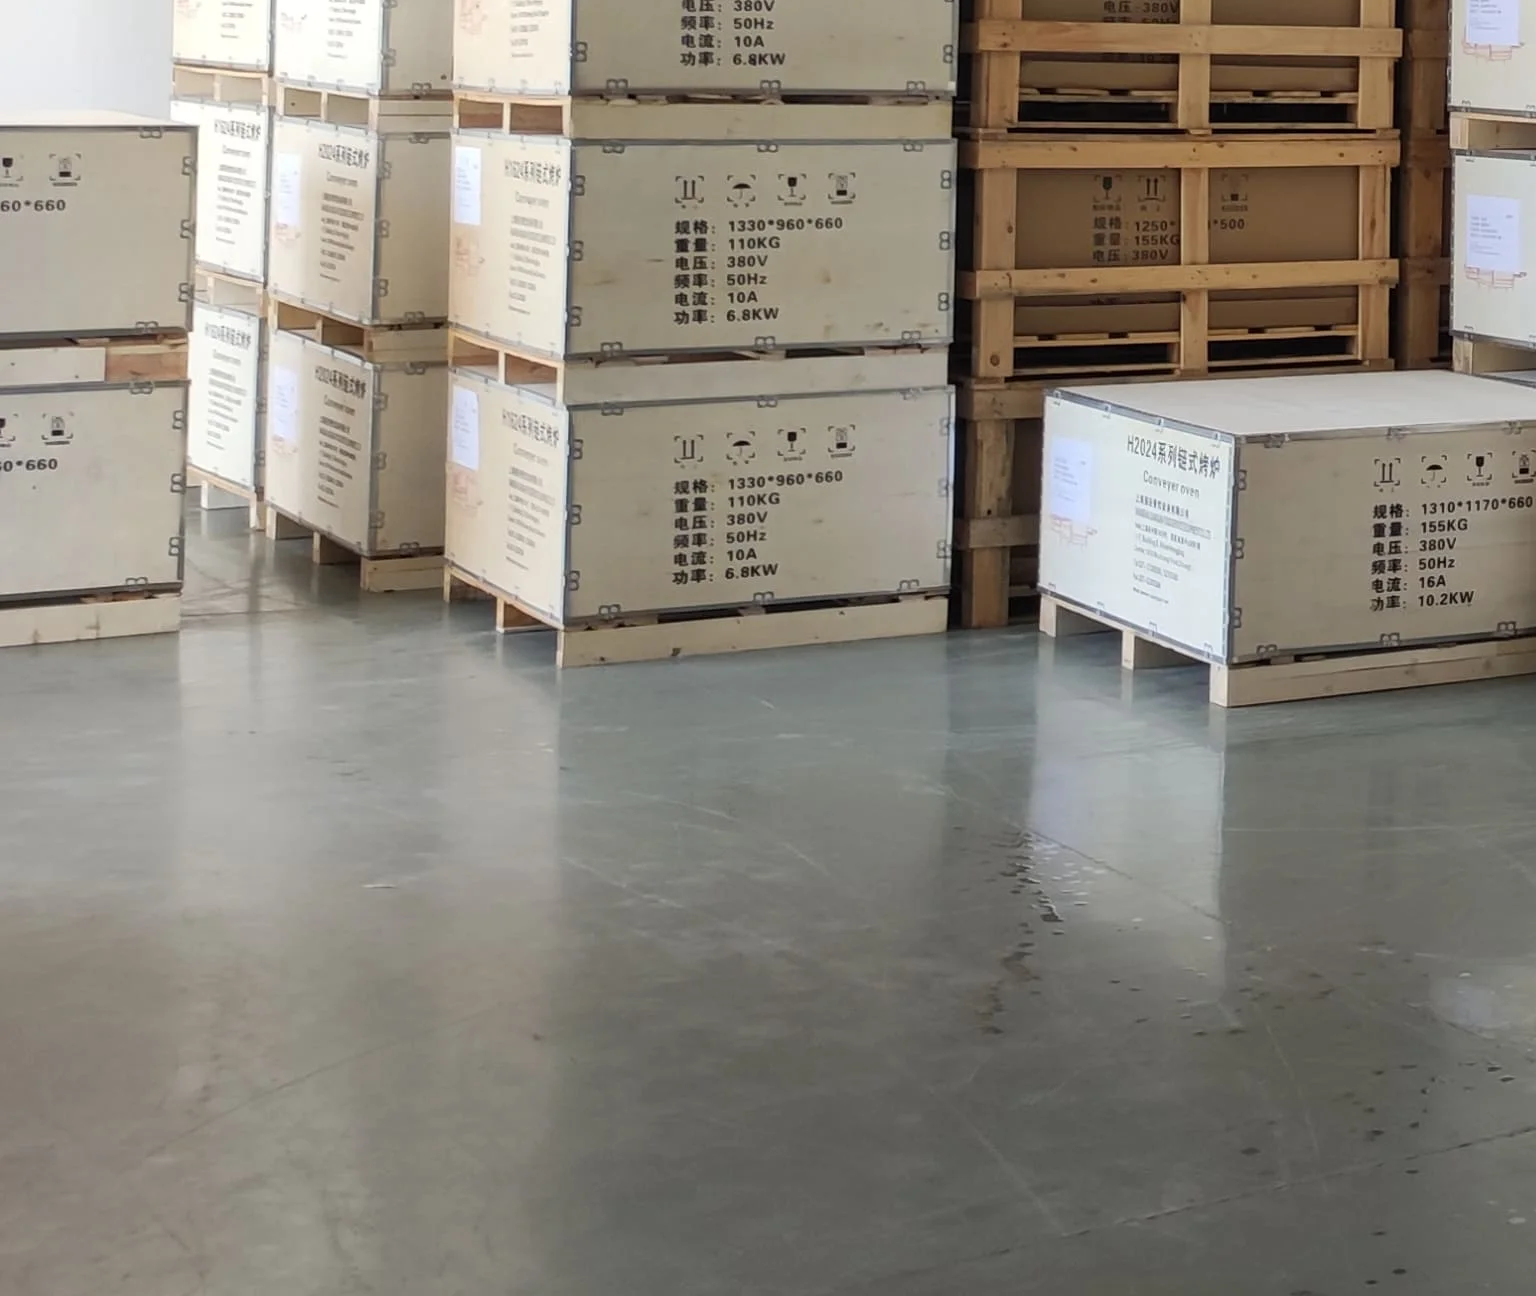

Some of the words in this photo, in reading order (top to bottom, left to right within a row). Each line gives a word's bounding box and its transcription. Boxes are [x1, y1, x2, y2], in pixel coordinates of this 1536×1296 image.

[733, 0, 775, 12] 380V
[733, 17, 774, 30] 50Hz
[734, 35, 764, 48] 10A
[733, 53, 785, 66] 6.8KW
[729, 236, 780, 251] 110KG
[1134, 234, 1180, 246] 155KG
[727, 255, 768, 268] 380V
[1132, 250, 1169, 261] 380V
[727, 273, 767, 286] 50Hz
[727, 290, 758, 304] 10A
[726, 308, 779, 322] 6.8KW
[1127, 434, 1221, 480] H2024系列链式烤炉
[1143, 470, 1179, 493] Conveyer
[1180, 484, 1200, 499] oven
[728, 492, 780, 508] 110KG
[727, 511, 768, 526] 380V
[1421, 518, 1468, 533] 155KG
[726, 530, 766, 544] 50Hz
[1419, 537, 1456, 552] 380V
[727, 548, 757, 562] 10A
[1419, 556, 1455, 570] 50Hz
[725, 563, 778, 579] 6.8KW
[1419, 575, 1446, 589] 16A
[1418, 591, 1474, 607] 10.2KW
